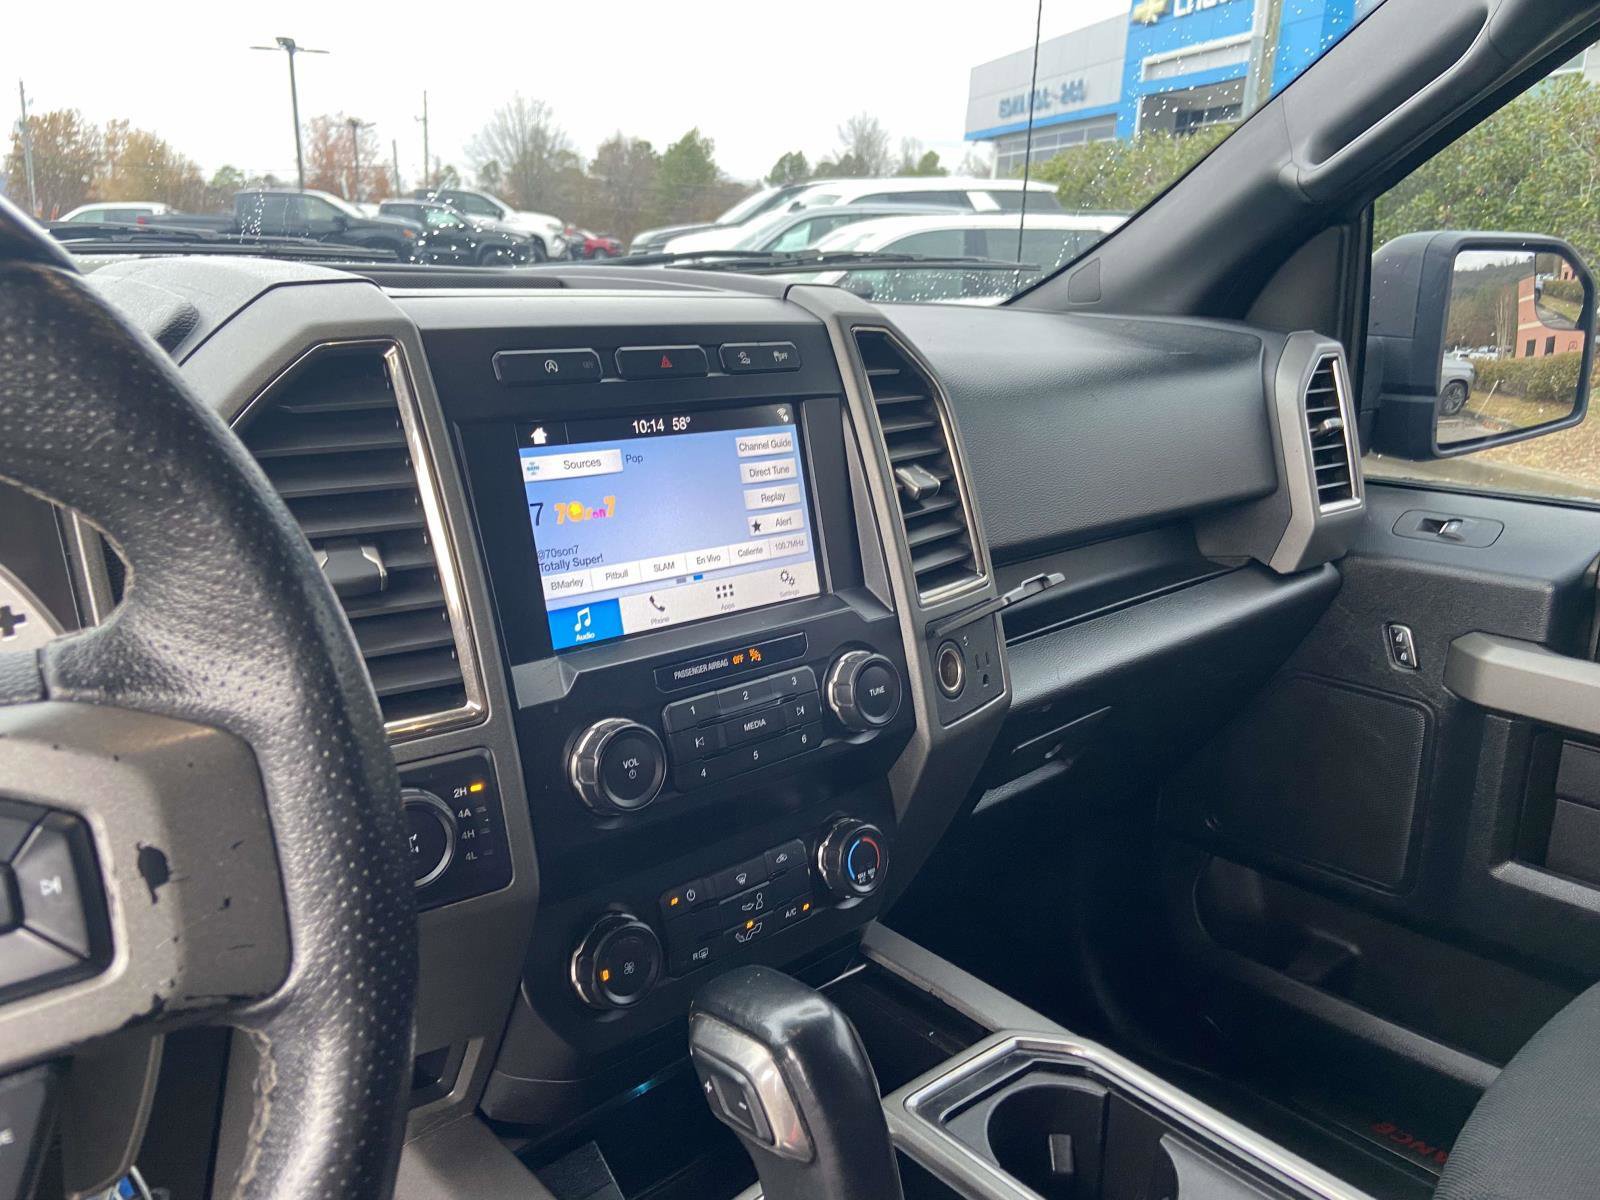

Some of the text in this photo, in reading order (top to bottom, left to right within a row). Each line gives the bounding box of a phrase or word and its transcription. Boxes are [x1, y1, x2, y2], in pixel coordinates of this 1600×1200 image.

[632, 416, 691, 434] 10:14 58°
[738, 437, 792, 452] Channel Guide
[563, 459, 602, 471] Sources
[625, 453, 644, 465] Pop
[749, 464, 790, 478] Direct Tune
[760, 491, 786, 504] Replay
[530, 502, 544, 526] 7
[775, 516, 793, 527] Alert
[538, 544, 579, 561] @70son7
[539, 553, 604, 574] Totally Super!
[696, 553, 721, 565] En Vivo
[653, 561, 676, 573] SLAM
[605, 569, 629, 581] Pitbull
[551, 578, 584, 591] BMarley
[575, 632, 595, 642] Audio
[673, 653, 744, 680] PASSENGER AIRBAG OFF
[791, 676, 797, 687] 3
[743, 691, 749, 701] 2
[868, 685, 886, 697] TUNE
[689, 706, 696, 716] 1
[743, 718, 767, 732] MEDIA
[801, 734, 808, 744] 6
[752, 750, 759, 760] 5
[622, 758, 640, 770] VOL
[700, 767, 707, 778] 4
[453, 786, 467, 799] 2H
[457, 808, 472, 819] 4A
[461, 829, 475, 840] 4H
[465, 851, 478, 861] 4L
[784, 907, 797, 919] A/C
